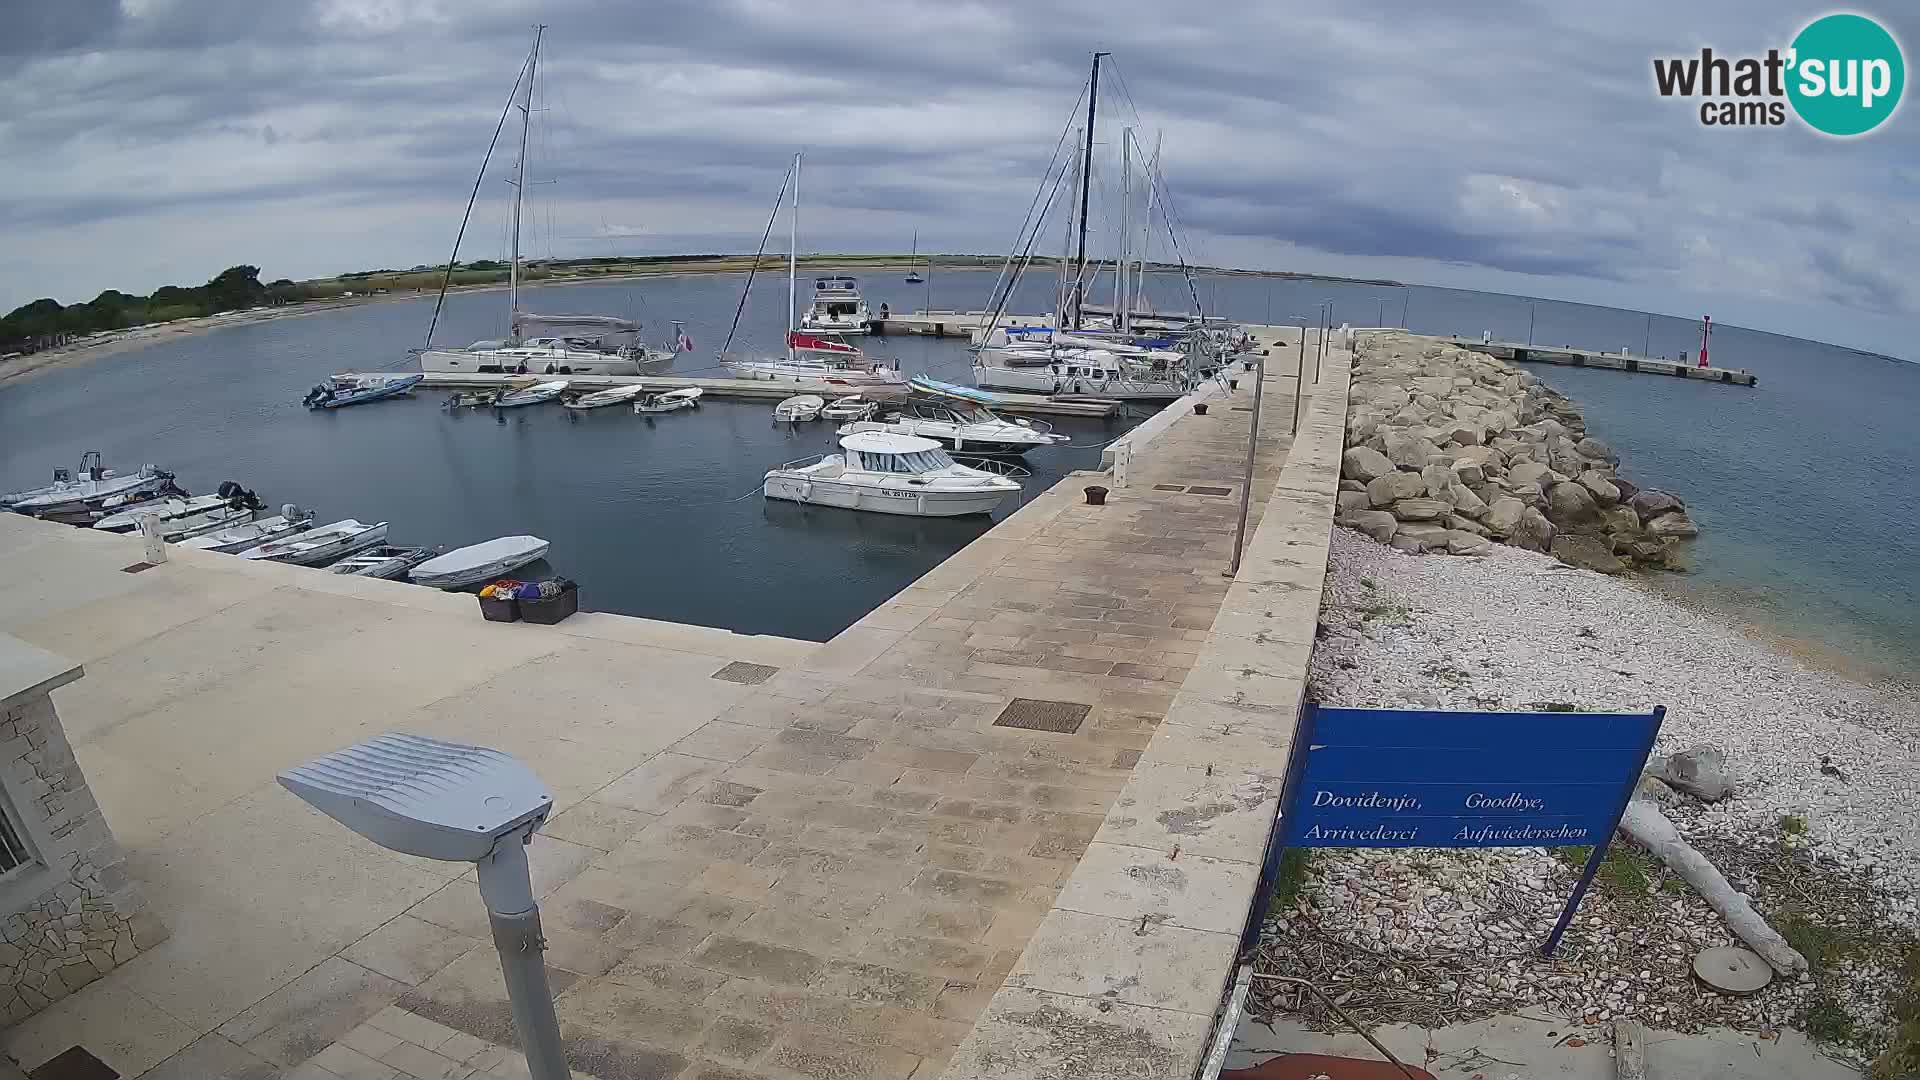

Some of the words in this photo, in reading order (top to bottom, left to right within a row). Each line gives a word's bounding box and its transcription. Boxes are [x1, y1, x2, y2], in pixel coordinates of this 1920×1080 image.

[1465, 792, 1545, 812] Goodbye,
[1304, 824, 1418, 840] Arrivederci
[1453, 823, 1588, 842] Aufwiedersehen
